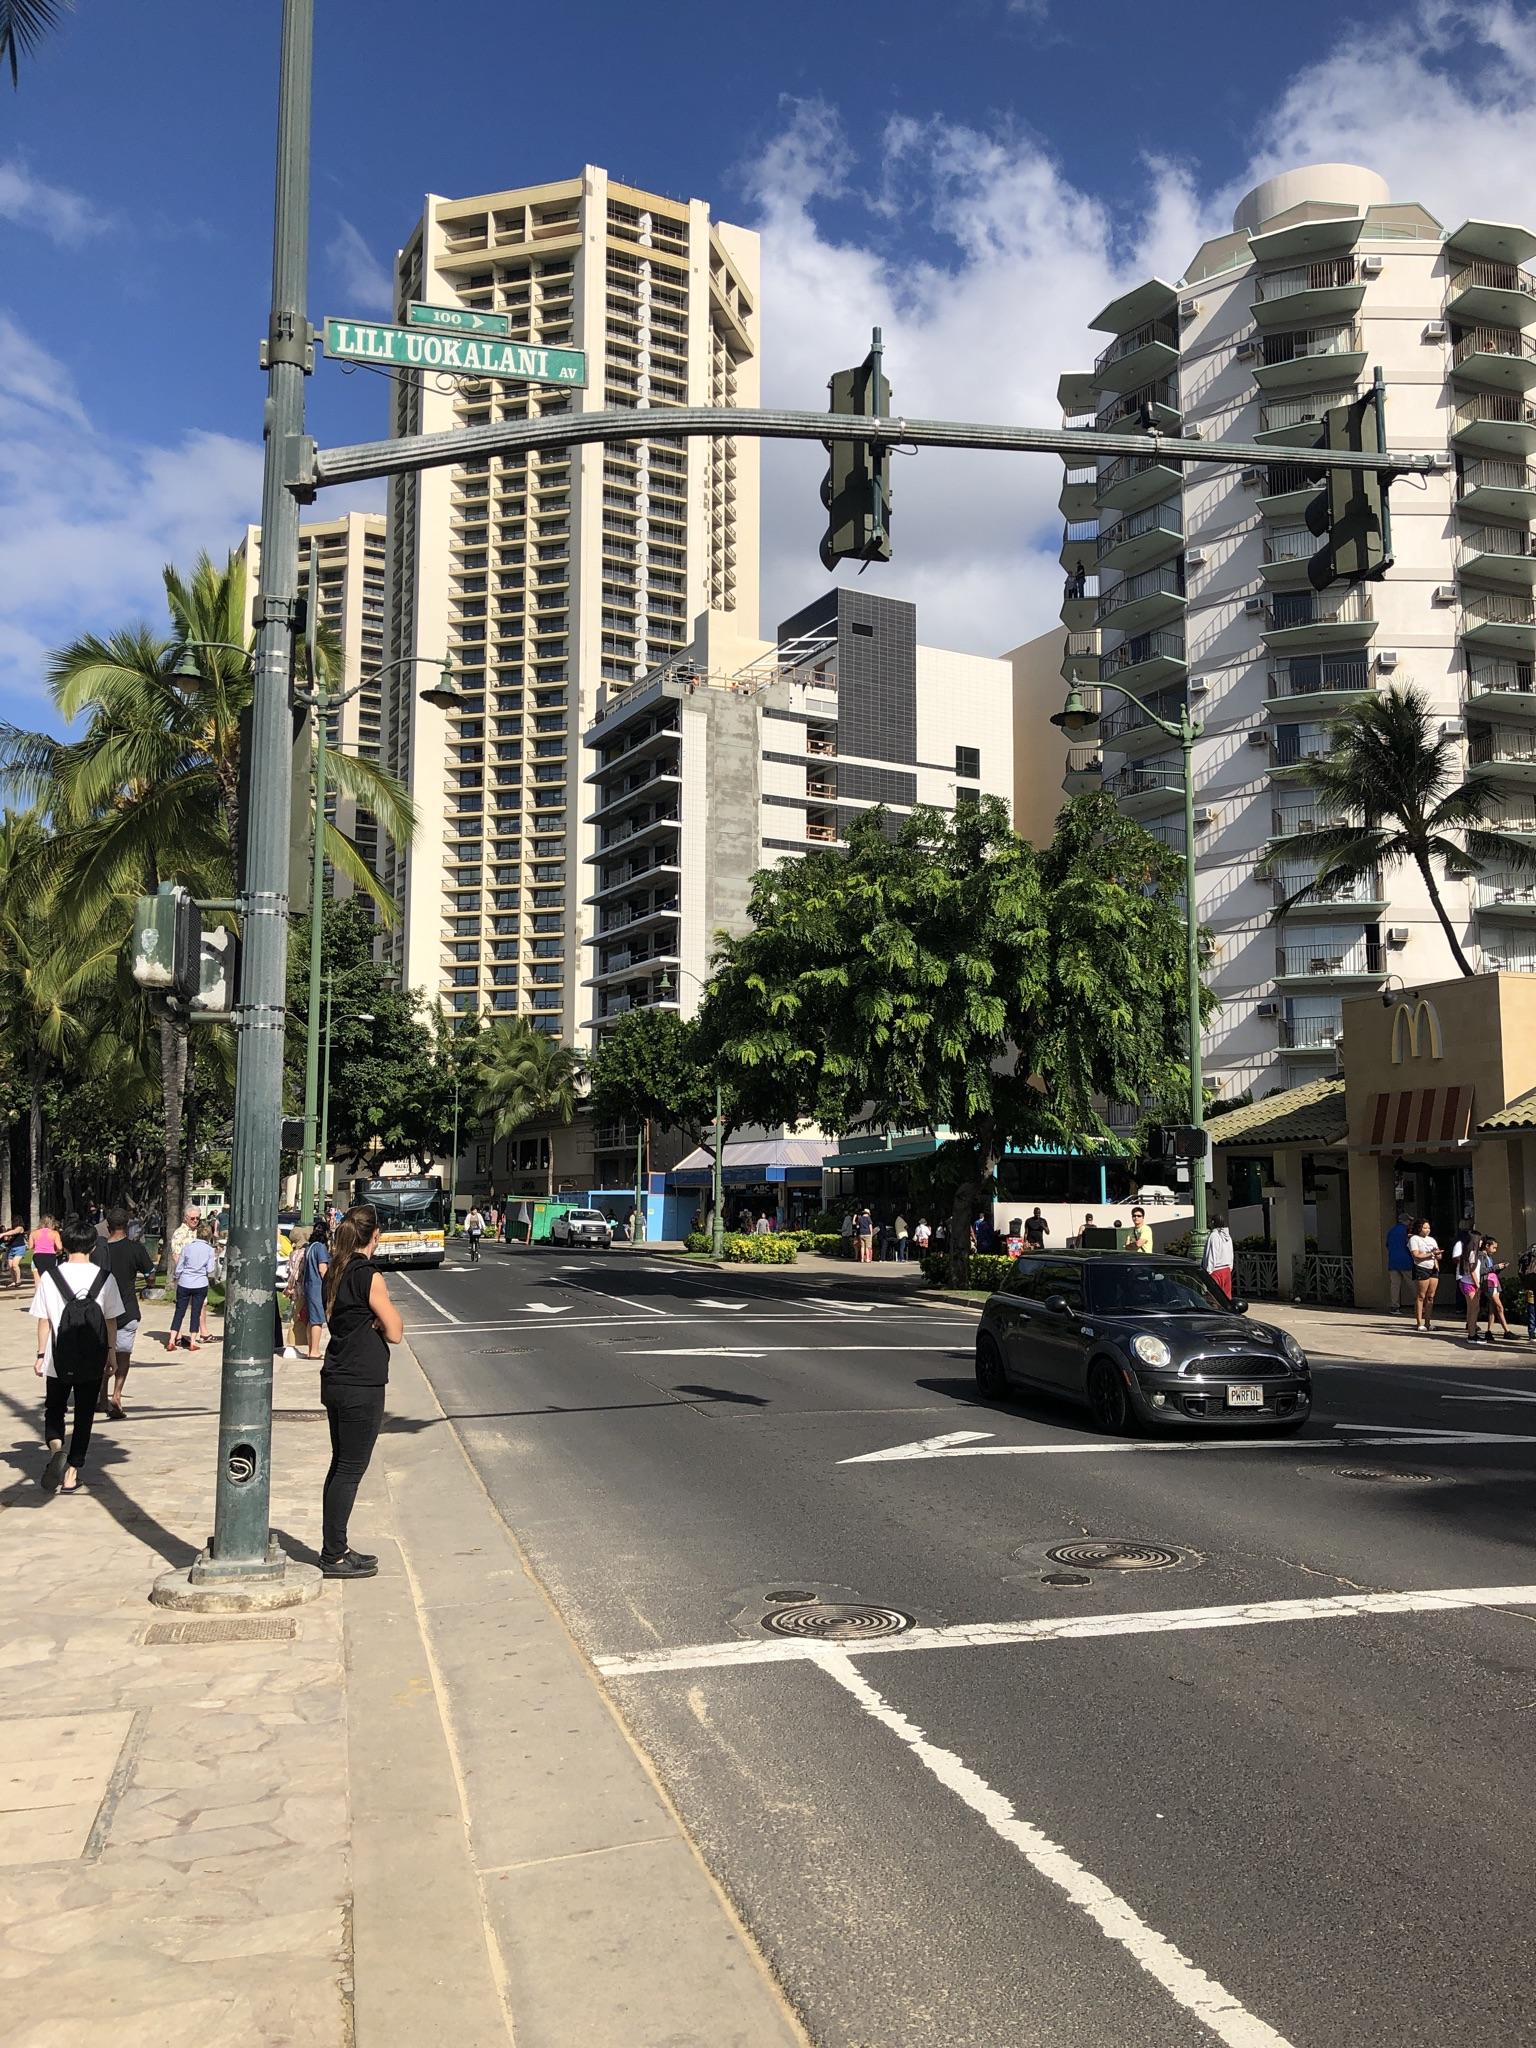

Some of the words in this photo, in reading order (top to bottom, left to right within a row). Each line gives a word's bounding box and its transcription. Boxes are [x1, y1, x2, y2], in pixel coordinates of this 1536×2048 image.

[433, 311, 462, 325] 100
[559, 367, 577, 379] AV
[370, 1181, 382, 1190] 22
[1231, 1390, 1260, 1401] PWRFUL
